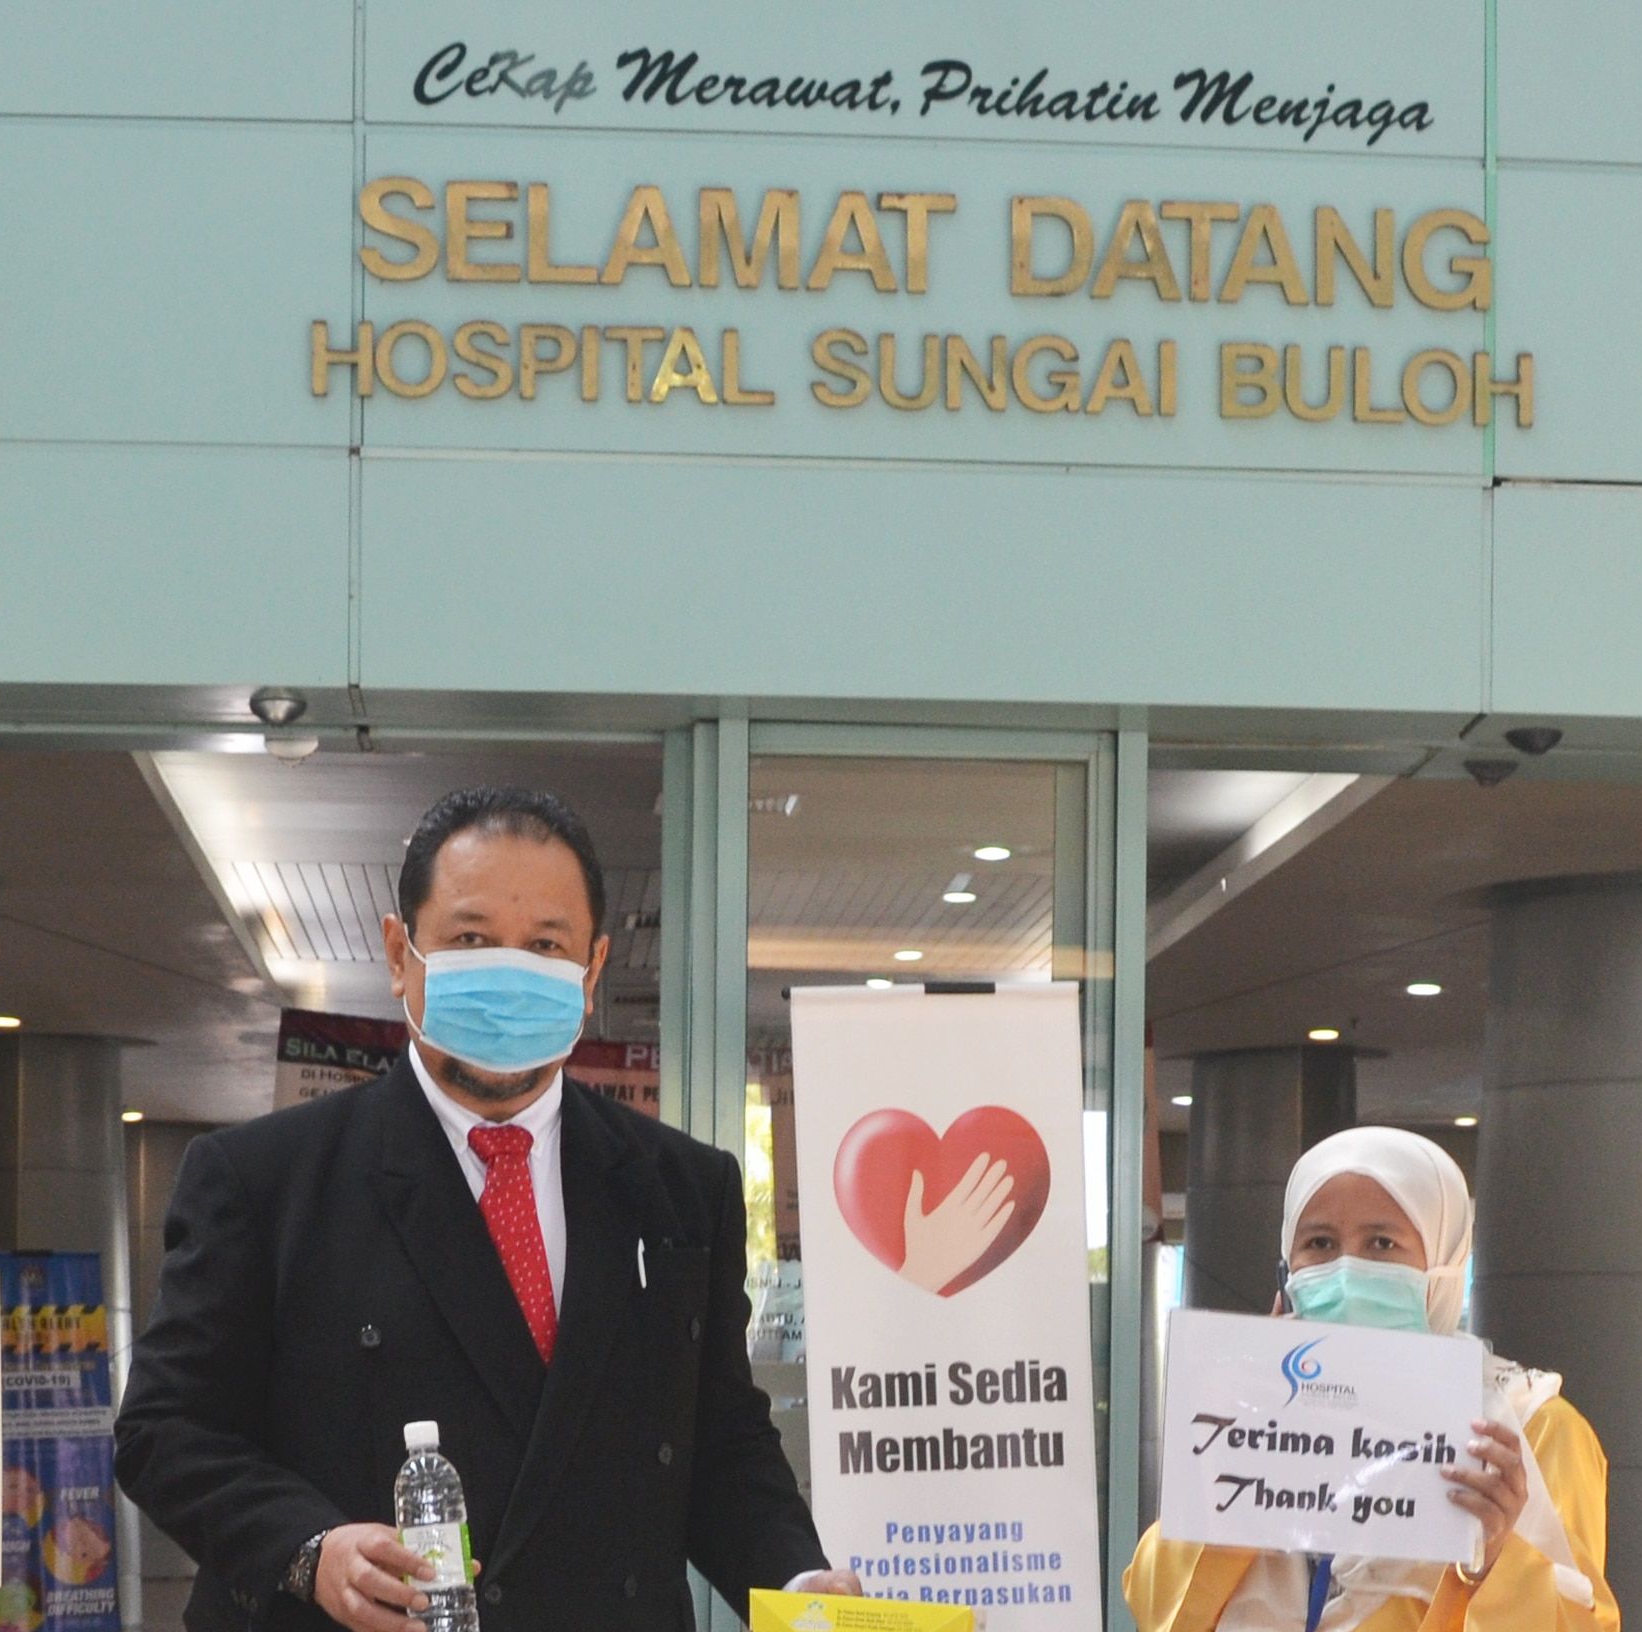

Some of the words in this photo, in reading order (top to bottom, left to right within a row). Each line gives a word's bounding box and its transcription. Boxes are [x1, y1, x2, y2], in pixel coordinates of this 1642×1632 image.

[616, 47, 902, 117] Merawat,
[919, 59, 1160, 120] Prihatin
[1173, 68, 1436, 145] Menjaga
[357, 176, 957, 294] SELAMAT
[1009, 195, 1493, 312] DATANG
[308, 320, 776, 408] HOSPITAL
[809, 327, 1179, 418] SUNGAI
[1218, 341, 1536, 429] BULOH
[285, 1037, 338, 1060] SILA
[830, 1363, 937, 1411] Kami
[948, 1360, 1069, 1405] Sedia
[1300, 1382, 1357, 1395] HOSPITAL
[838, 1428, 1065, 1475] Membantu
[1191, 1412, 1335, 1456] Terima
[1350, 1426, 1457, 1465] kasih
[1214, 1474, 1338, 1513] Thank
[1350, 1494, 1416, 1525] you
[886, 1520, 1024, 1544] Penyayang
[849, 1549, 1063, 1578] Profesionalisme
[919, 1582, 1072, 1606] Berpasukan
